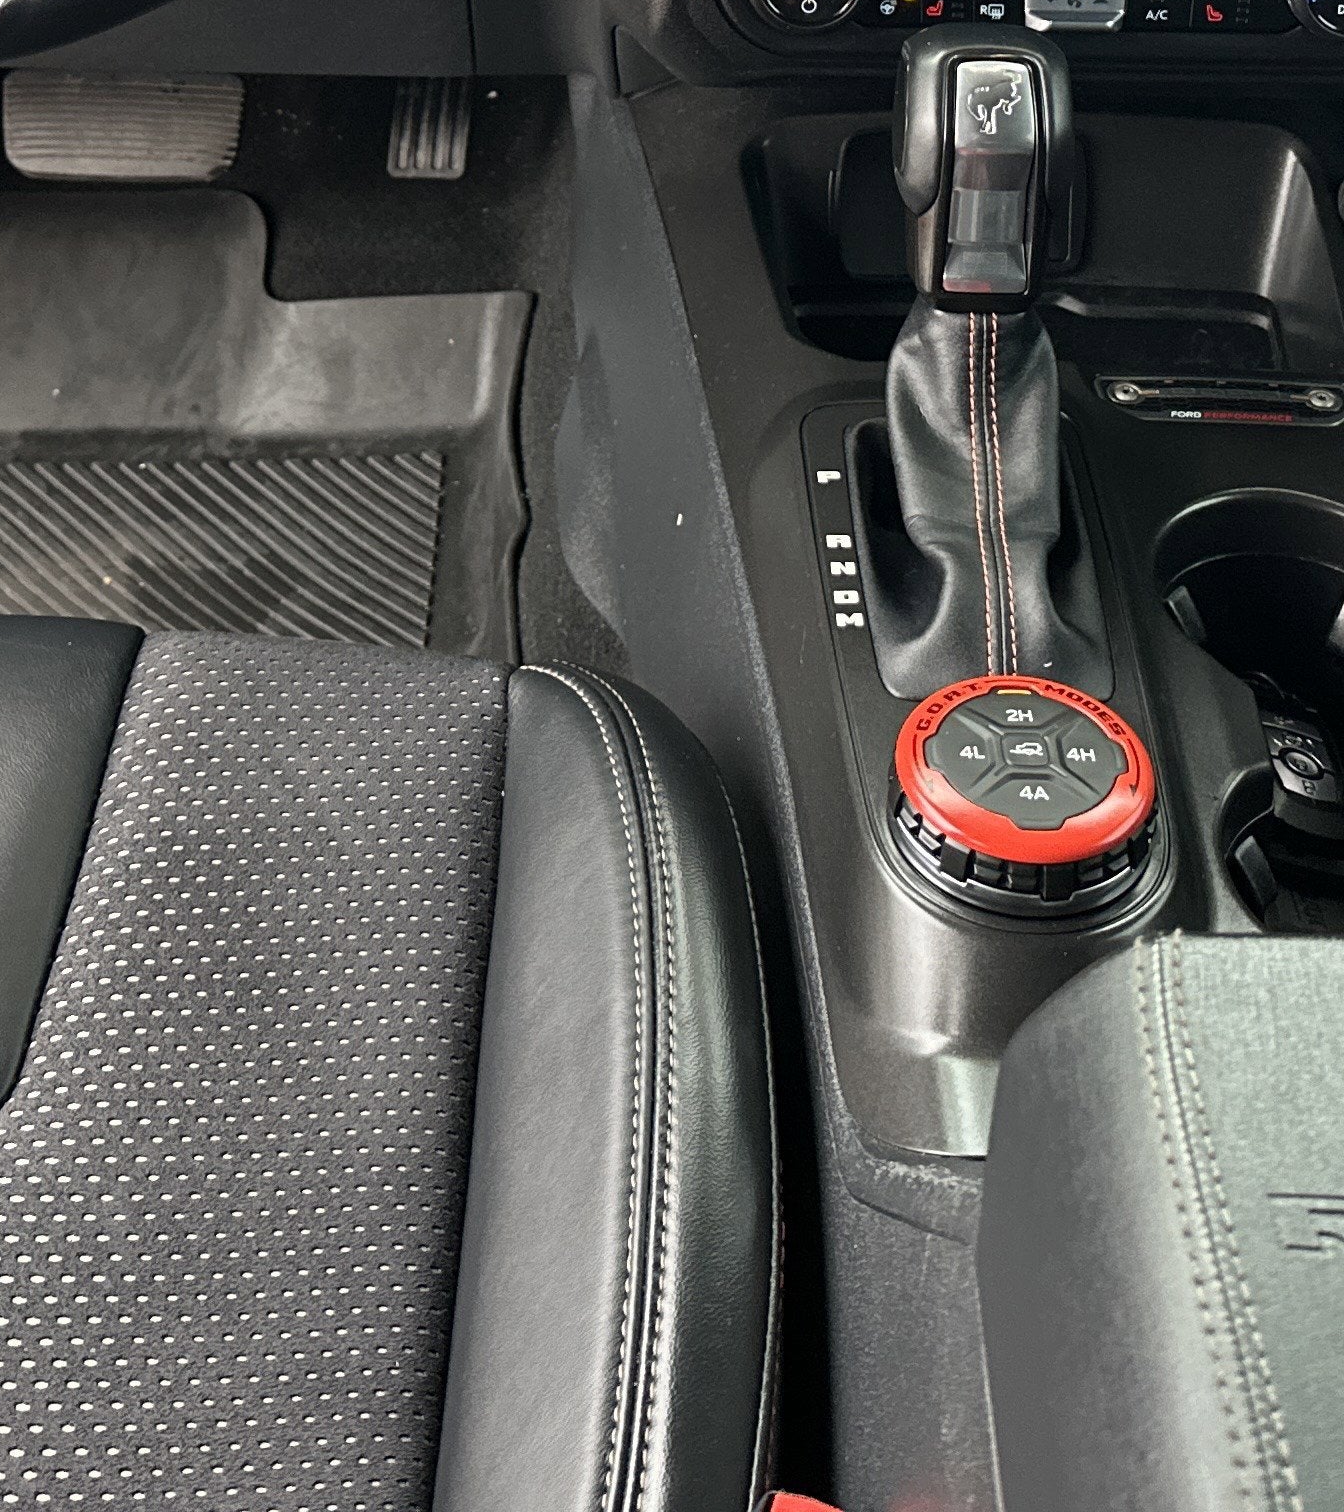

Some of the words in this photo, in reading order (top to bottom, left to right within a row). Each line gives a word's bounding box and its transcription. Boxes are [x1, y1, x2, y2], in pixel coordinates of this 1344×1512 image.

[1145, 9, 1169, 21] A/C
[1171, 410, 1202, 419] FORD
[1203, 411, 1294, 423] PERFORMANCE
[816, 470, 841, 484] P
[826, 534, 852, 548] R
[830, 561, 856, 576] N
[833, 590, 860, 604] D
[836, 612, 865, 627] M
[1006, 709, 1034, 723] 2H
[1043, 683, 1128, 737] MODES
[959, 746, 986, 760] 4L
[1066, 747, 1096, 762] 4H
[1019, 786, 1050, 801] 4A
